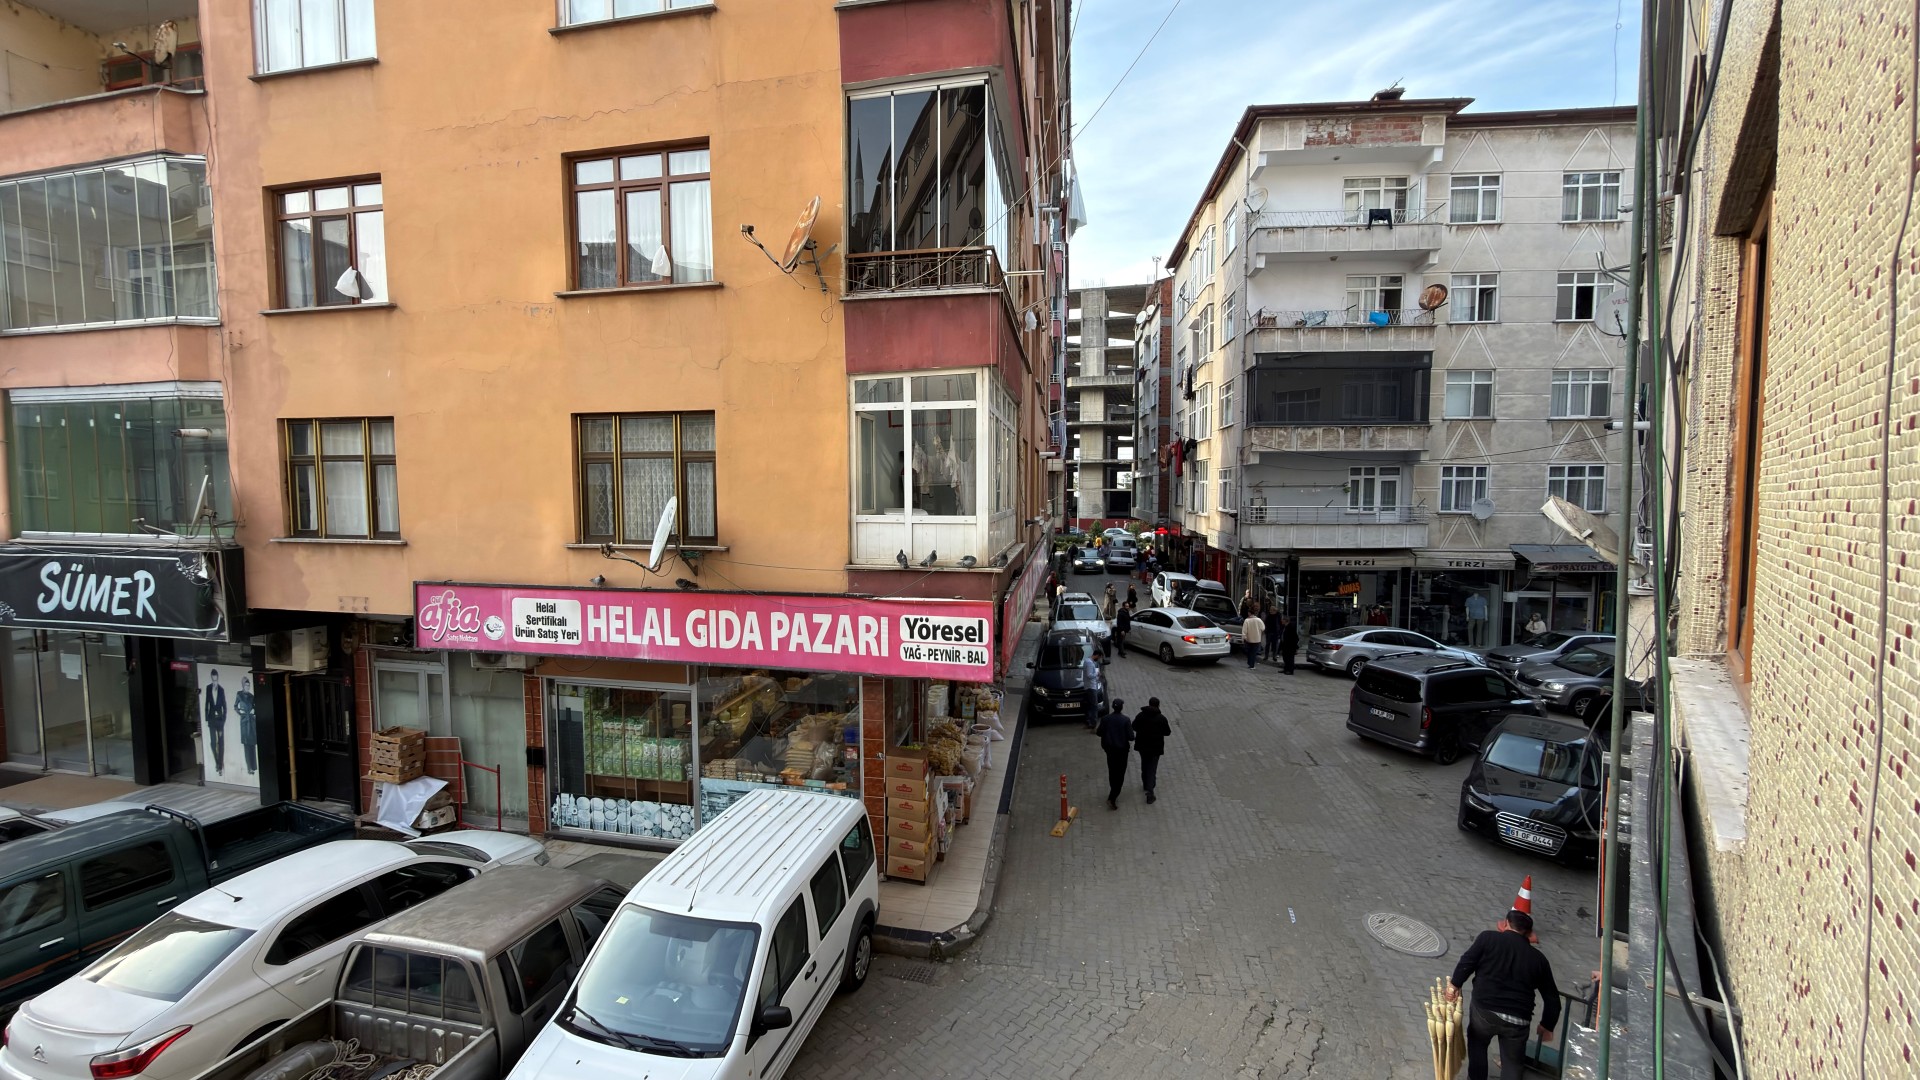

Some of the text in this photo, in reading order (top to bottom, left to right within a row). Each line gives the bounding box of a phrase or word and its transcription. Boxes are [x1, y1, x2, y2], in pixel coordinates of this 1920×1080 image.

[37, 561, 157, 623] SÜMER
[419, 590, 481, 642] afia
[535, 602, 557, 614] Helal
[526, 614, 567, 627] Sertifikalı
[905, 617, 984, 643] Yöresel
[515, 626, 535, 639] Ürün
[537, 628, 559, 643] Satış
[561, 629, 579, 641] Yeri
[587, 604, 889, 658] HELAL GIDA PAZARI
[903, 645, 922, 660] YAĞ
[927, 646, 961, 663] PEYNİR
[967, 650, 986, 664] BAL
[1510, 828, 1552, 846] 61 OF 0444
